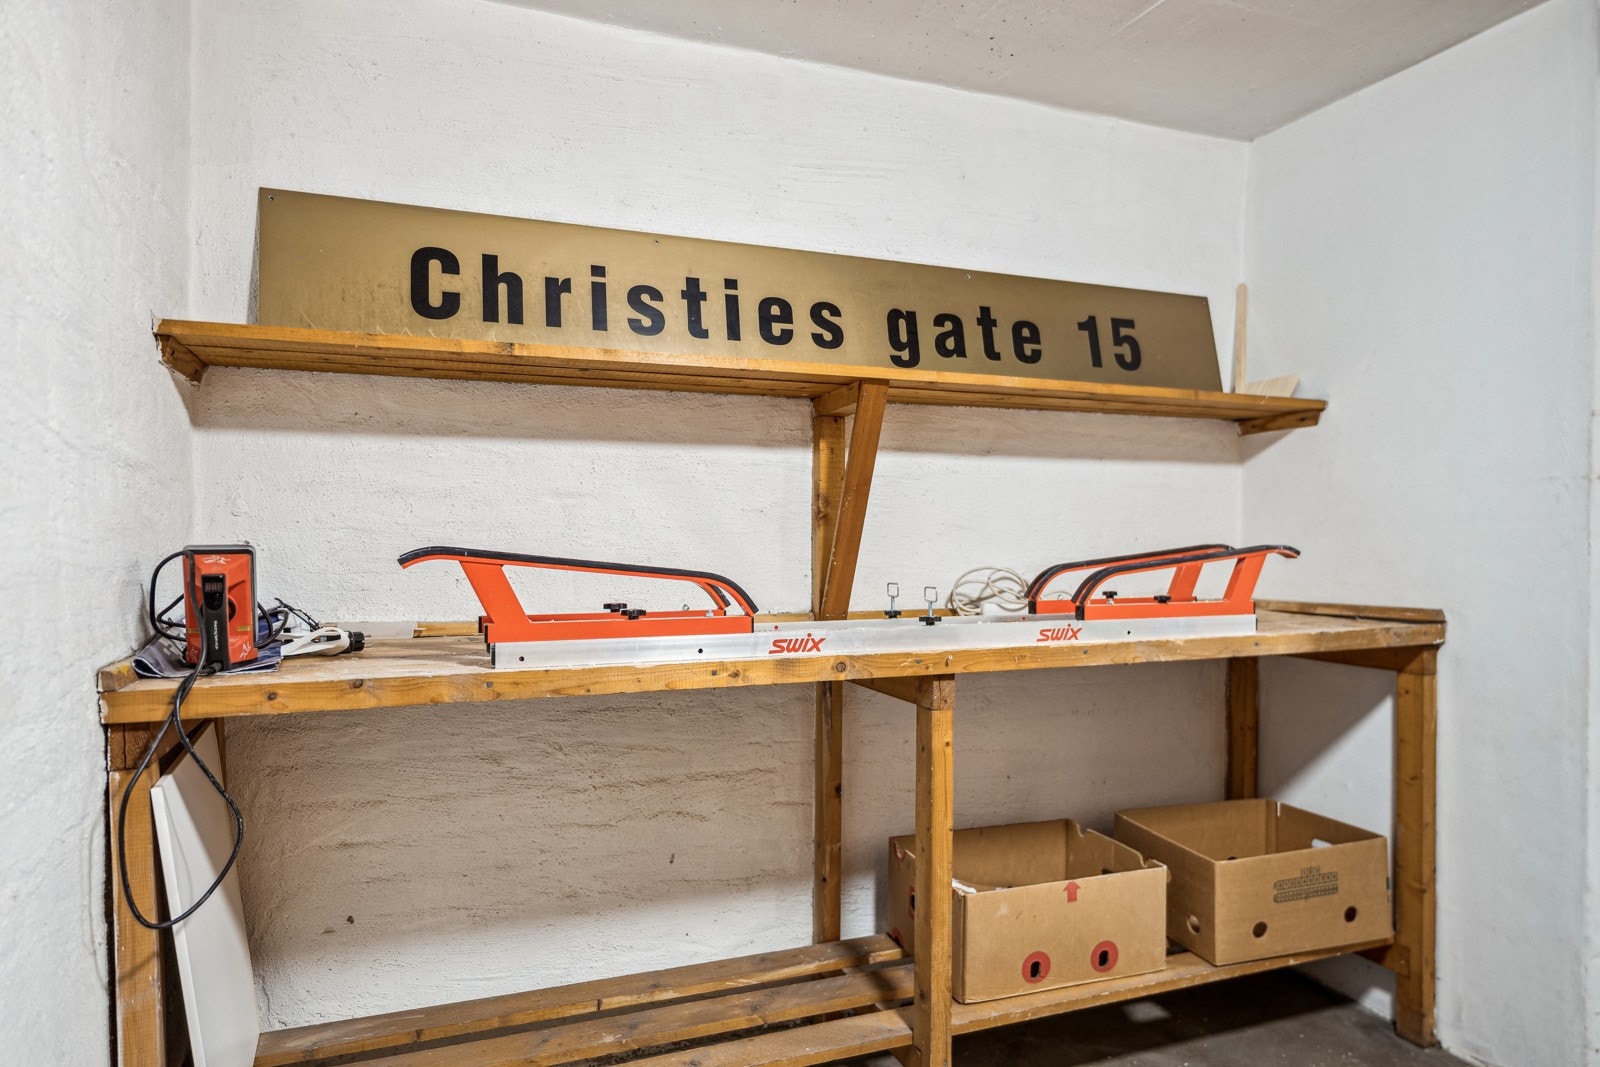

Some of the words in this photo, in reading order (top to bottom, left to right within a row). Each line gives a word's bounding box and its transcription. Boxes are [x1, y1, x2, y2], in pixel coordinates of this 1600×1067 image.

[410, 246, 845, 350] Christies
[886, 305, 1042, 369] gate
[1077, 315, 1142, 372] 15
